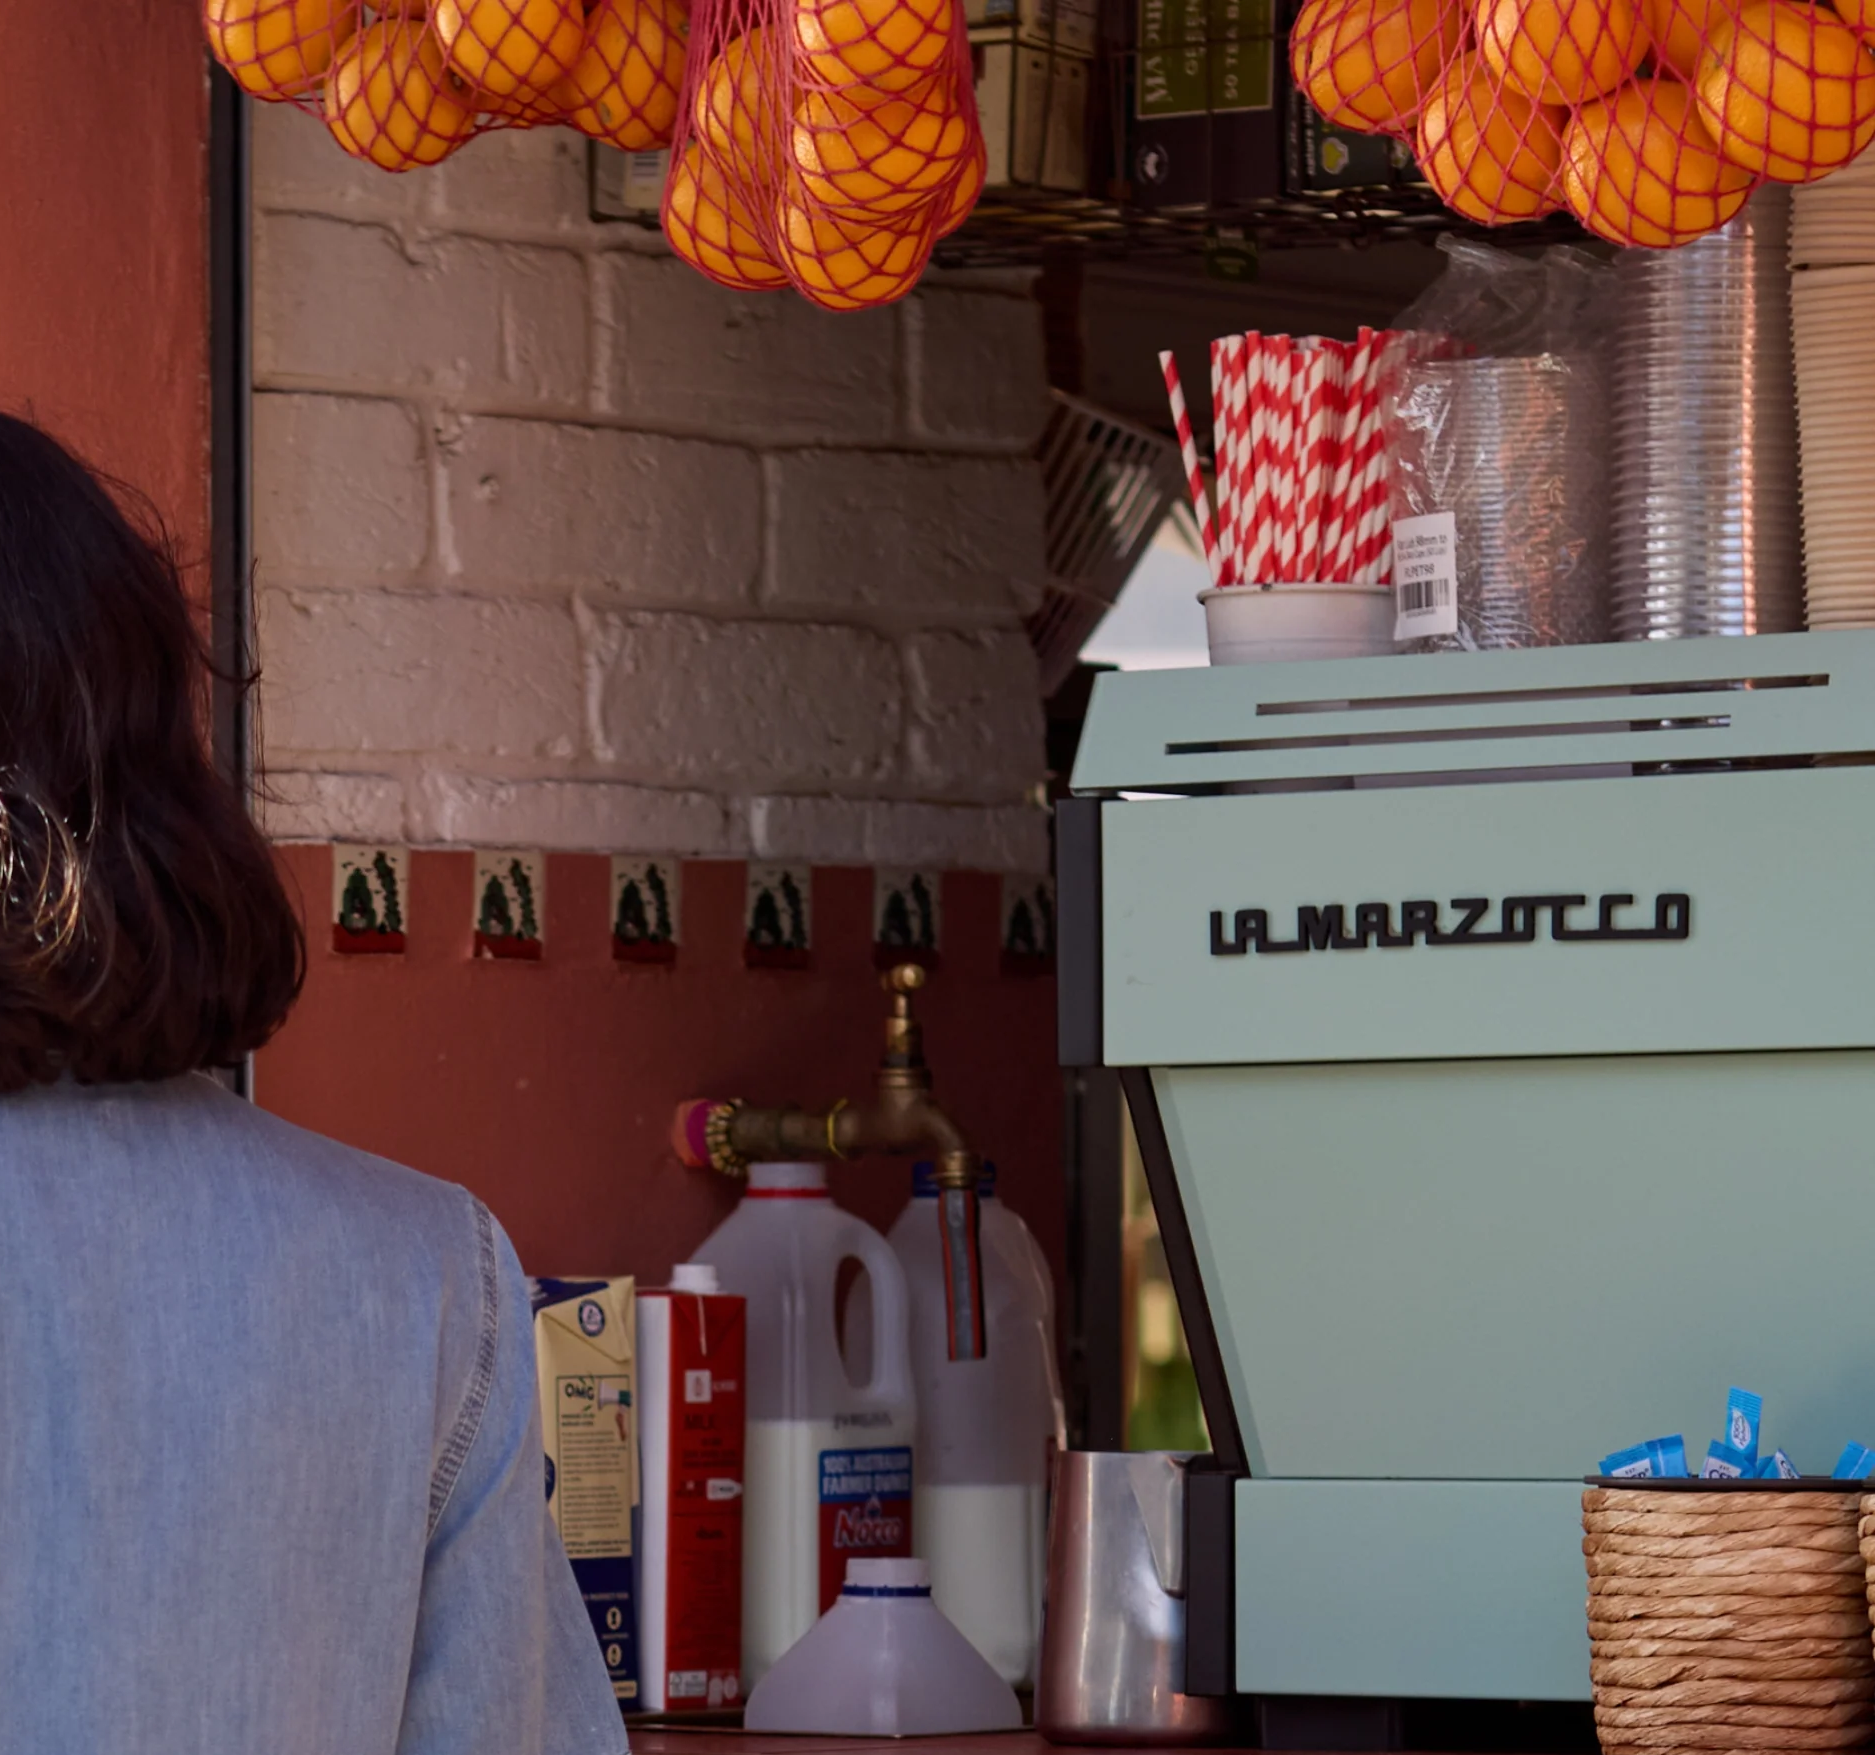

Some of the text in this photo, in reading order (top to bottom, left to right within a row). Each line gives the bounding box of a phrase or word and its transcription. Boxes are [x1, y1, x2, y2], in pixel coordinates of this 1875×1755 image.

[1210, 893, 1690, 956] LA MARZOCCO
[565, 1383, 595, 1401] OMG
